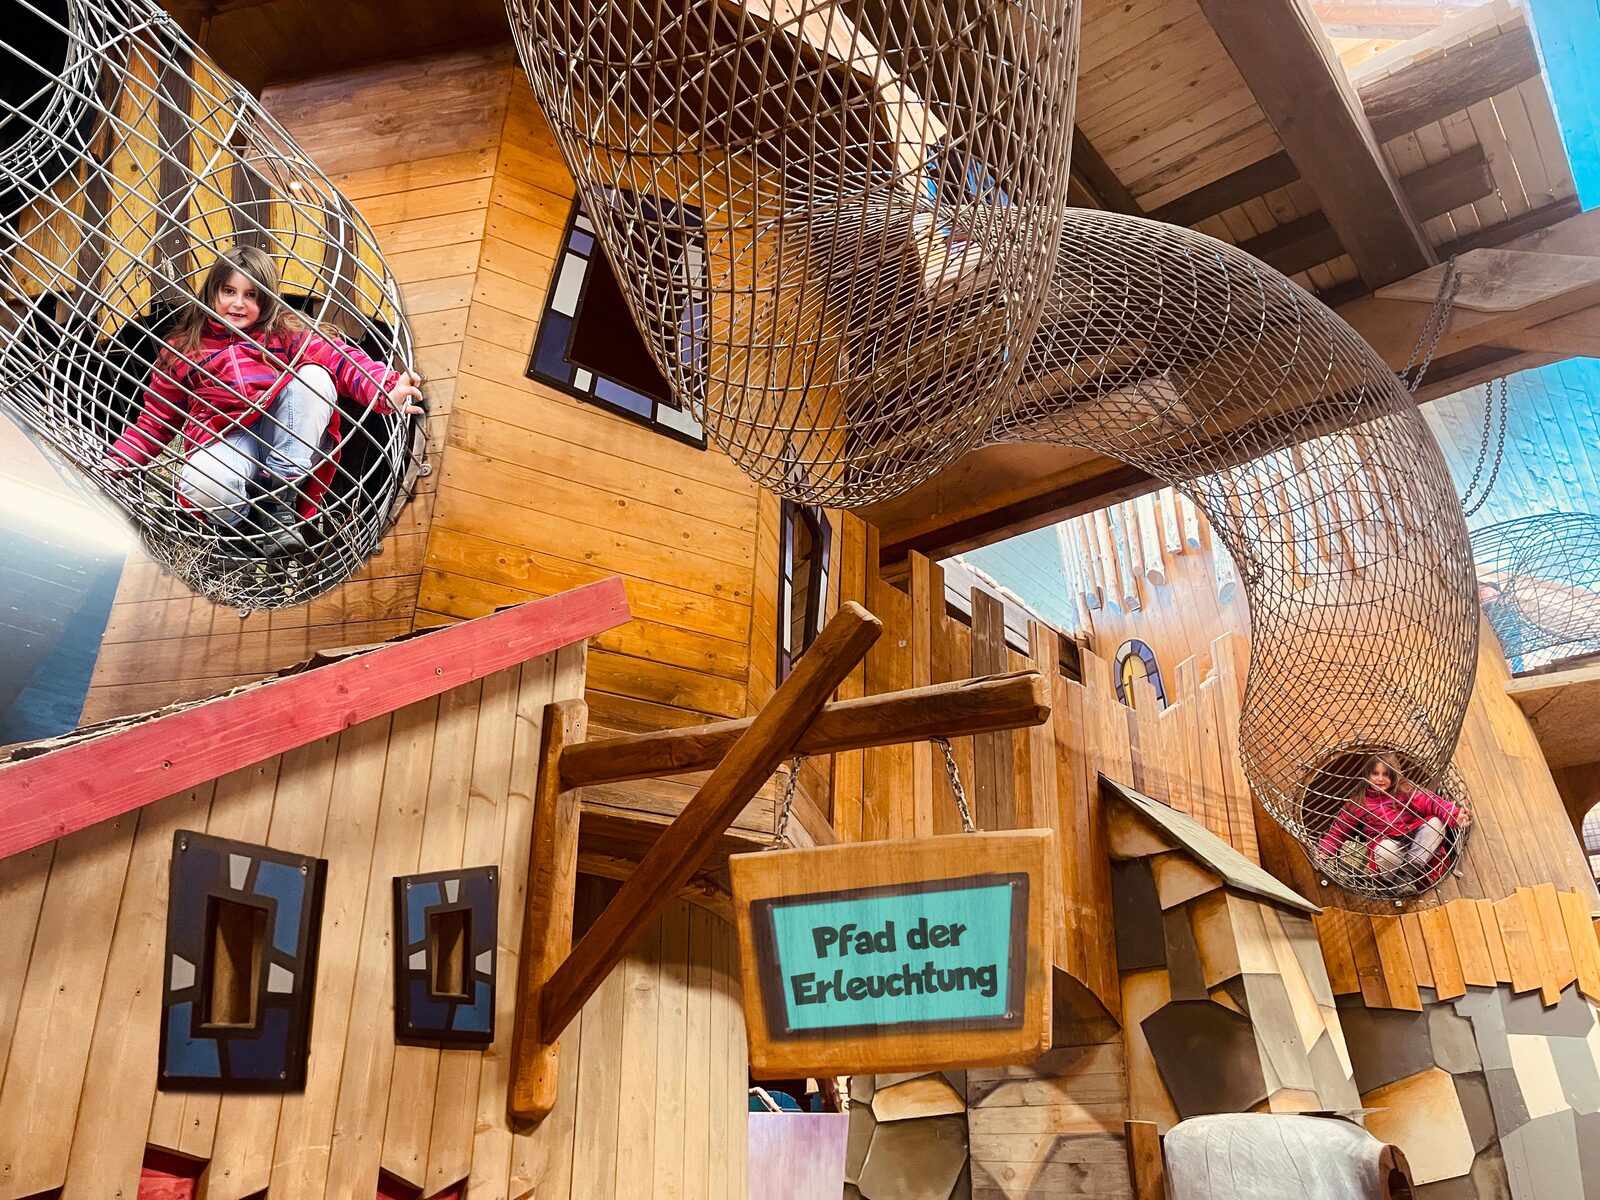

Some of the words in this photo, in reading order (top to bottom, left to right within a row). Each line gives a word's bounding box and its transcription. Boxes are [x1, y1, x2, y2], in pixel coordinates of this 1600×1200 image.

[812, 920, 896, 959] Pfad
[906, 917, 968, 950] der
[790, 961, 998, 1006] Erleuchtung
